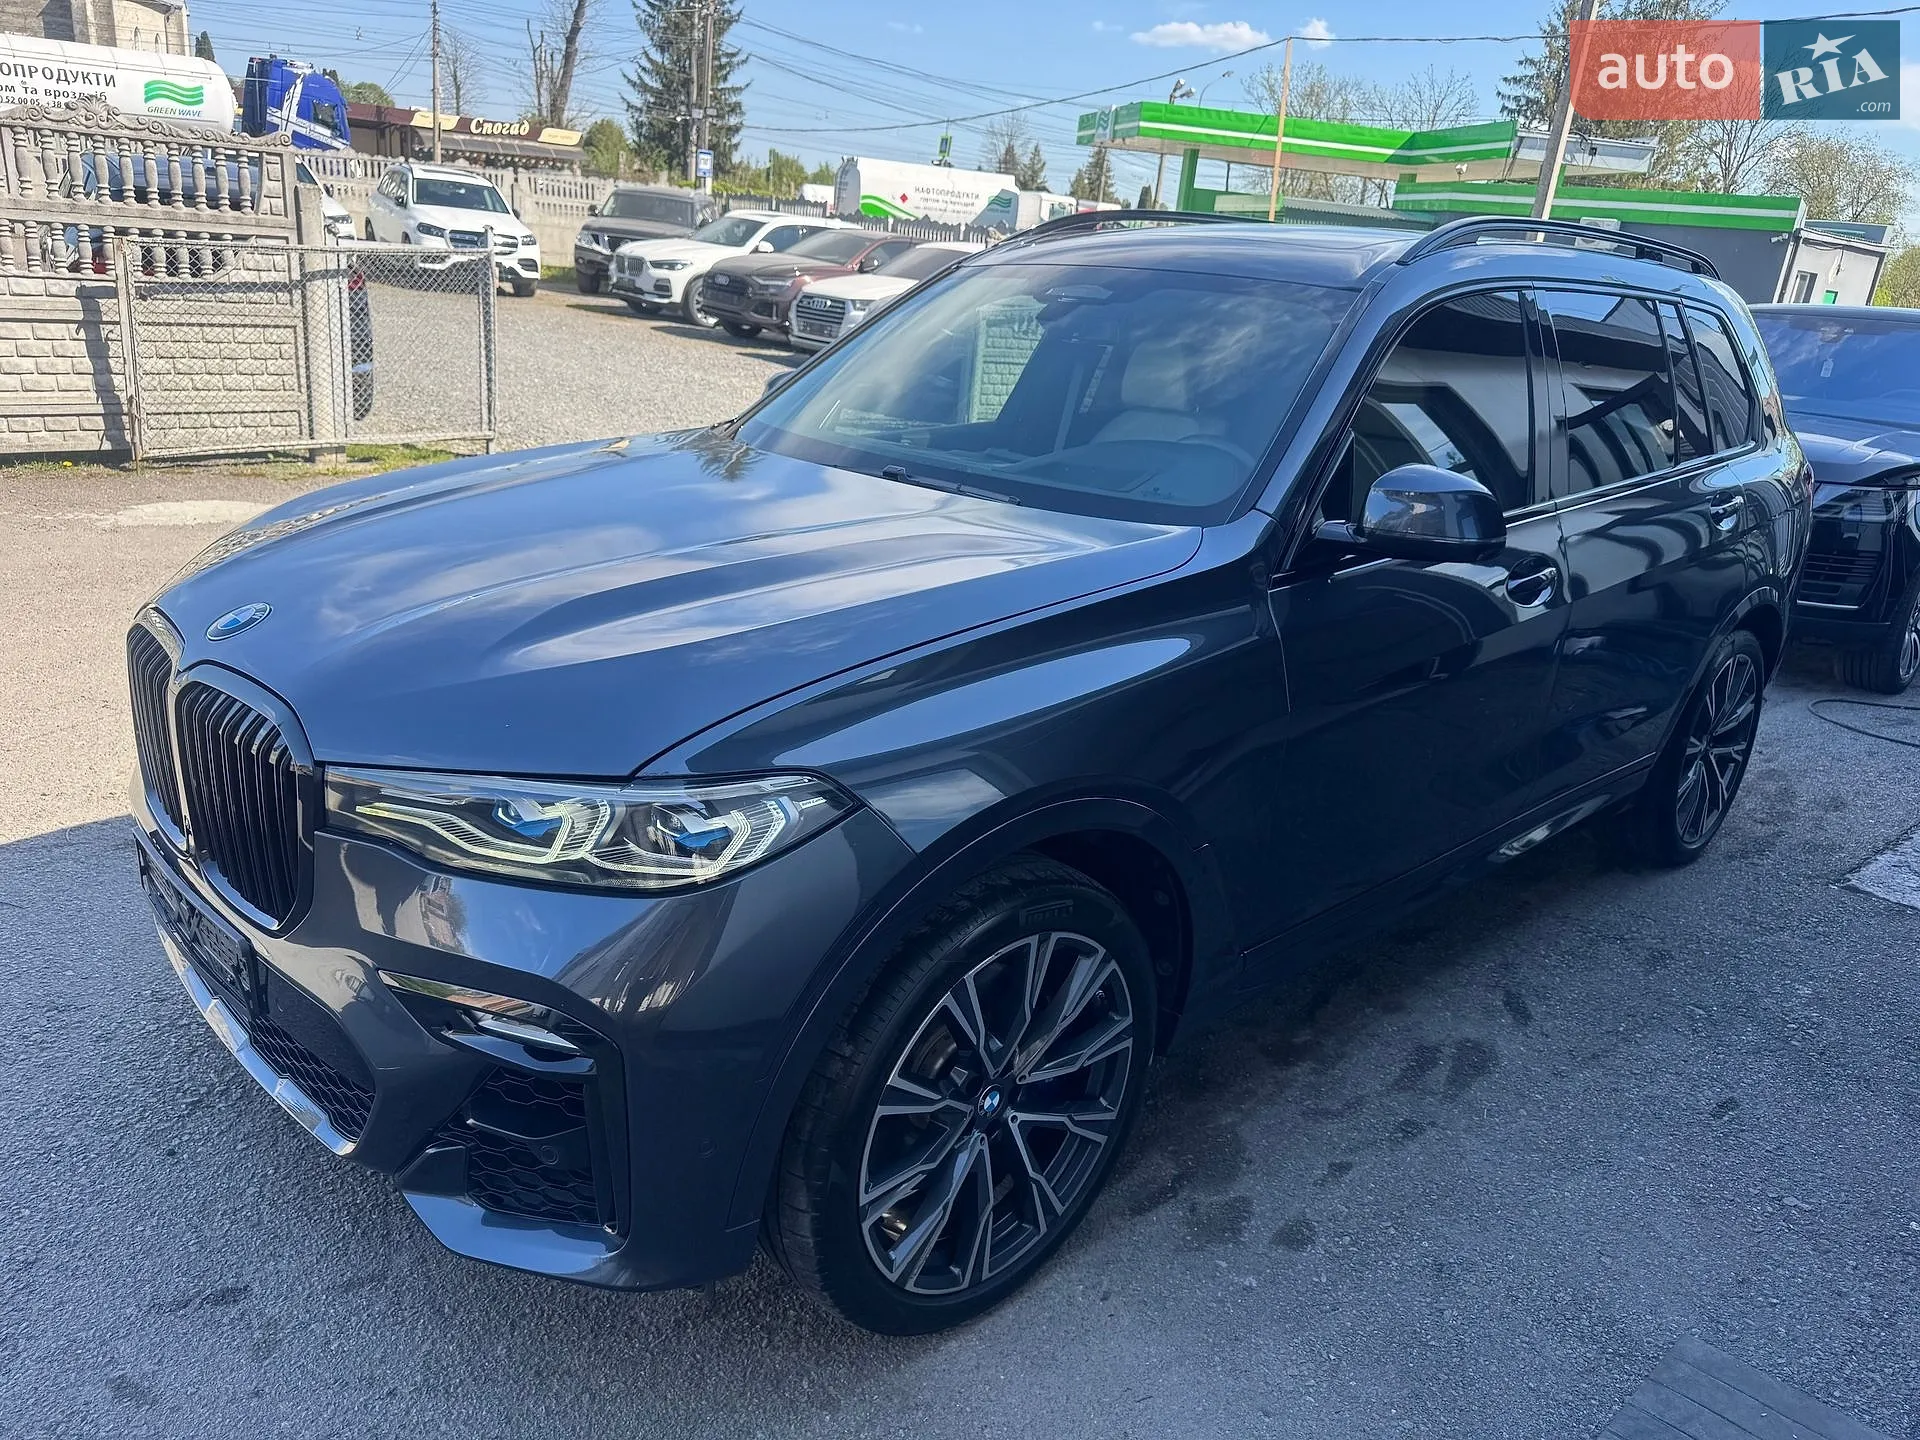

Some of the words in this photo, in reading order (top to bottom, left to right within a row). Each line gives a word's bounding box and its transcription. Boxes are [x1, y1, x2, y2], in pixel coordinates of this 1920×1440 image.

[18, 97, 28, 105] 00
[22, 86, 38, 95] та
[44, 88, 107, 103] вроздіб
[147, 106, 177, 115] GREEN
[178, 108, 203, 117] WAVE
[470, 117, 530, 136] Спогад
